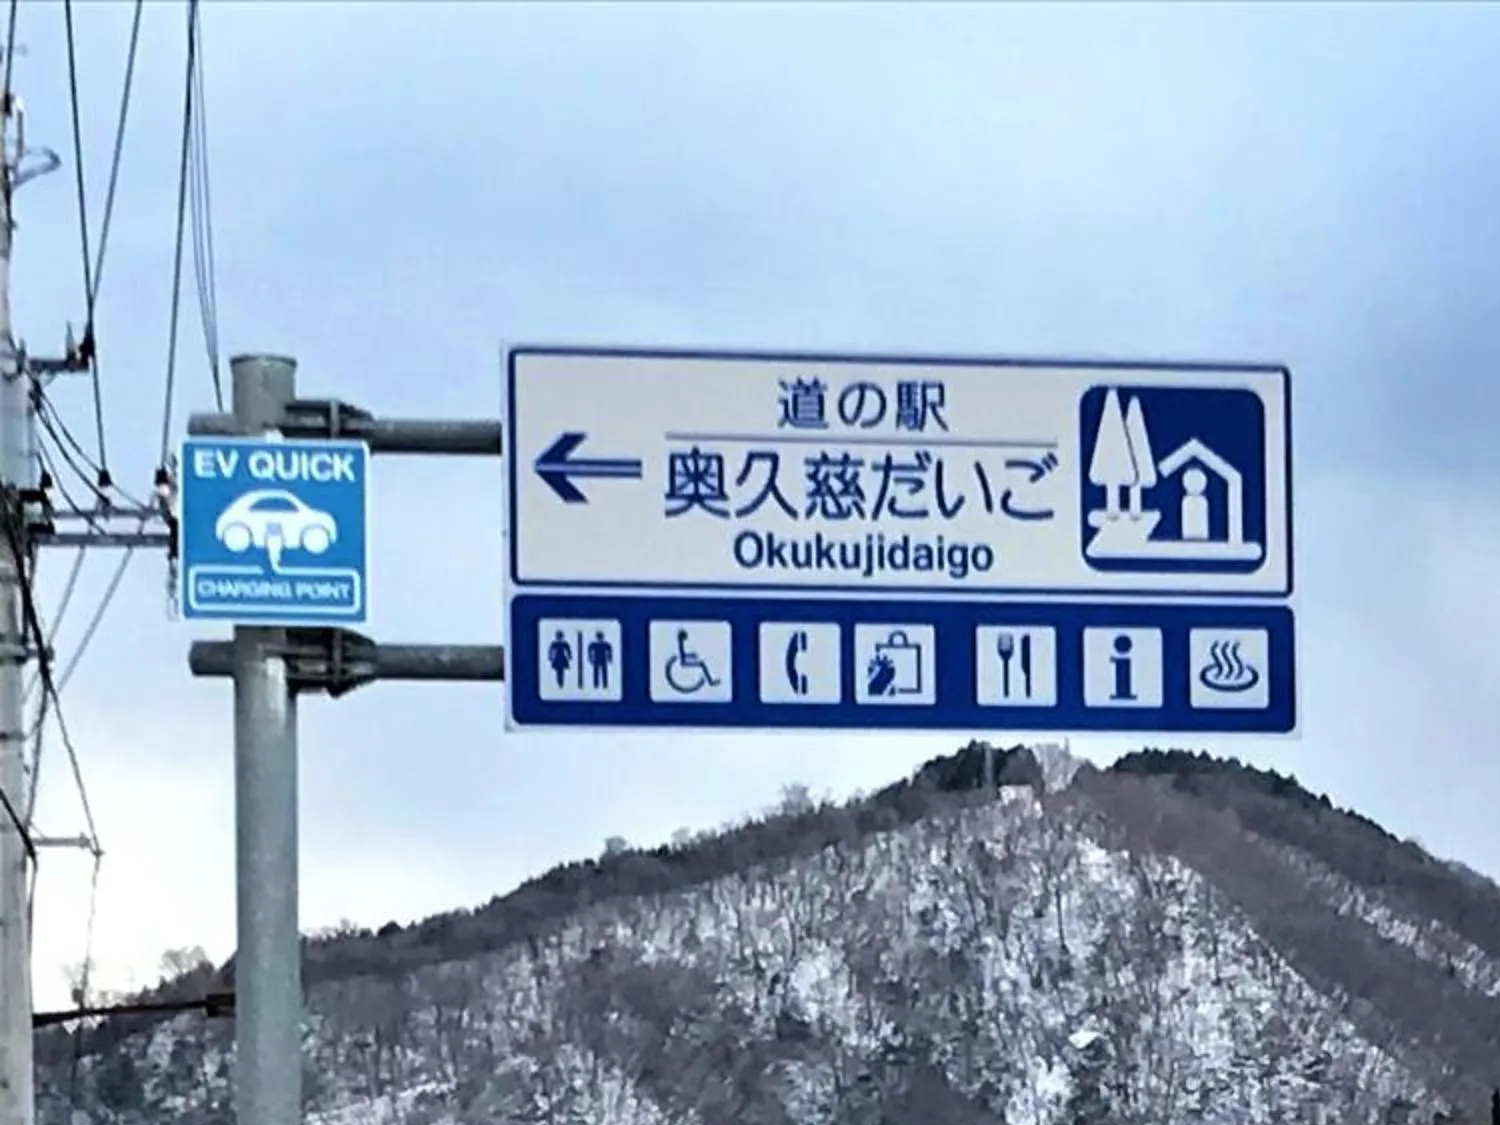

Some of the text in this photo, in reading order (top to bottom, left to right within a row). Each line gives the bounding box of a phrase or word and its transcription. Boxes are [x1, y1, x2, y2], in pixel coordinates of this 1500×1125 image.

[778, 377, 949, 433] 道の駅
[194, 448, 356, 482] EV QUICK
[664, 446, 1059, 523] 奥久慈だいご
[733, 529, 994, 578] Okukujidaigo
[295, 581, 352, 600] POINT
